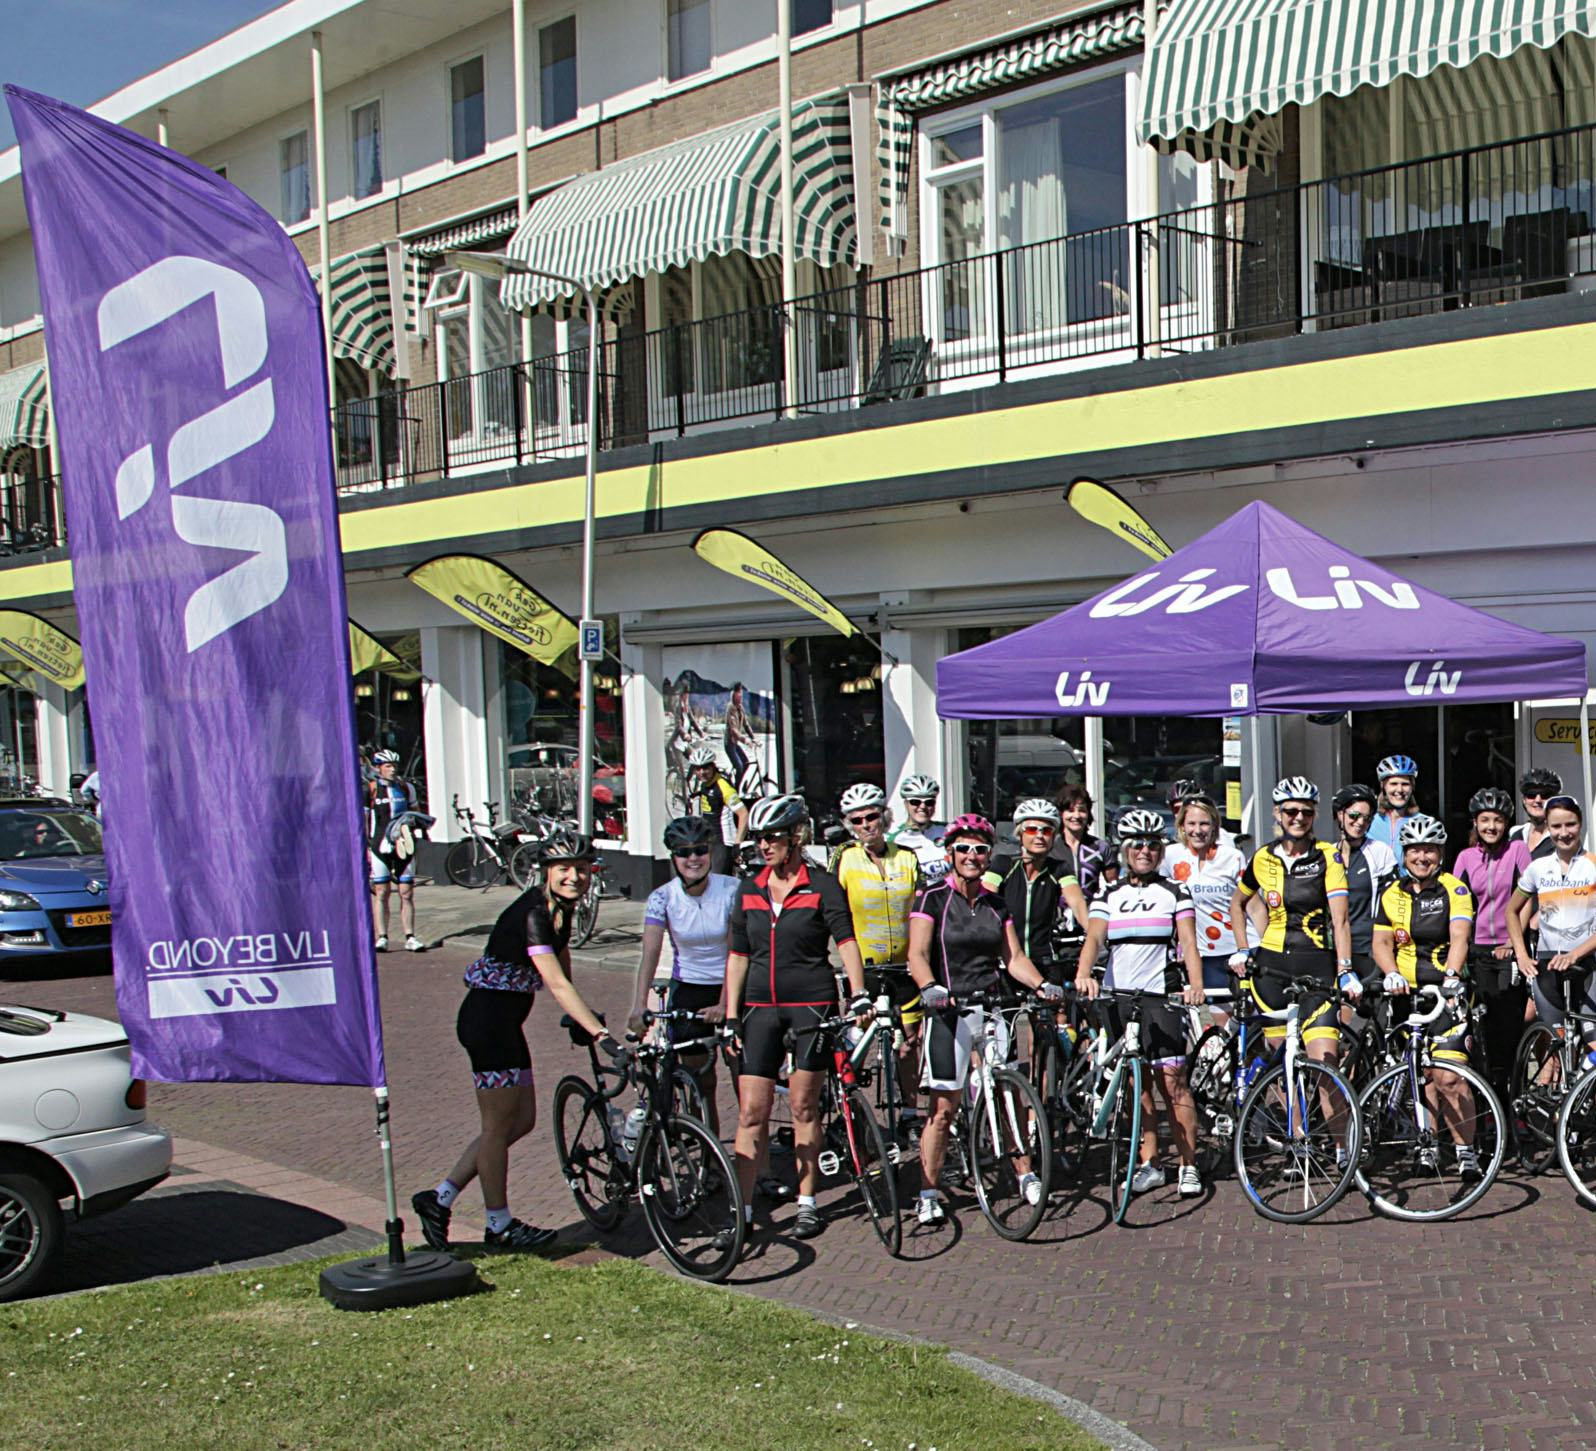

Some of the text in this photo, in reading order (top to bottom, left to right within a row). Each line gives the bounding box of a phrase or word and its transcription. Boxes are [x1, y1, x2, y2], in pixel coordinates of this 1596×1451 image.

[1089, 568, 1250, 618] Liv
[1266, 565, 1421, 610] Liv
[587, 630, 597, 643] P
[1055, 671, 1110, 707] Liv
[1404, 660, 1463, 696] Liv
[1540, 876, 1590, 888] Rabobank
[1119, 899, 1157, 913] Liv
